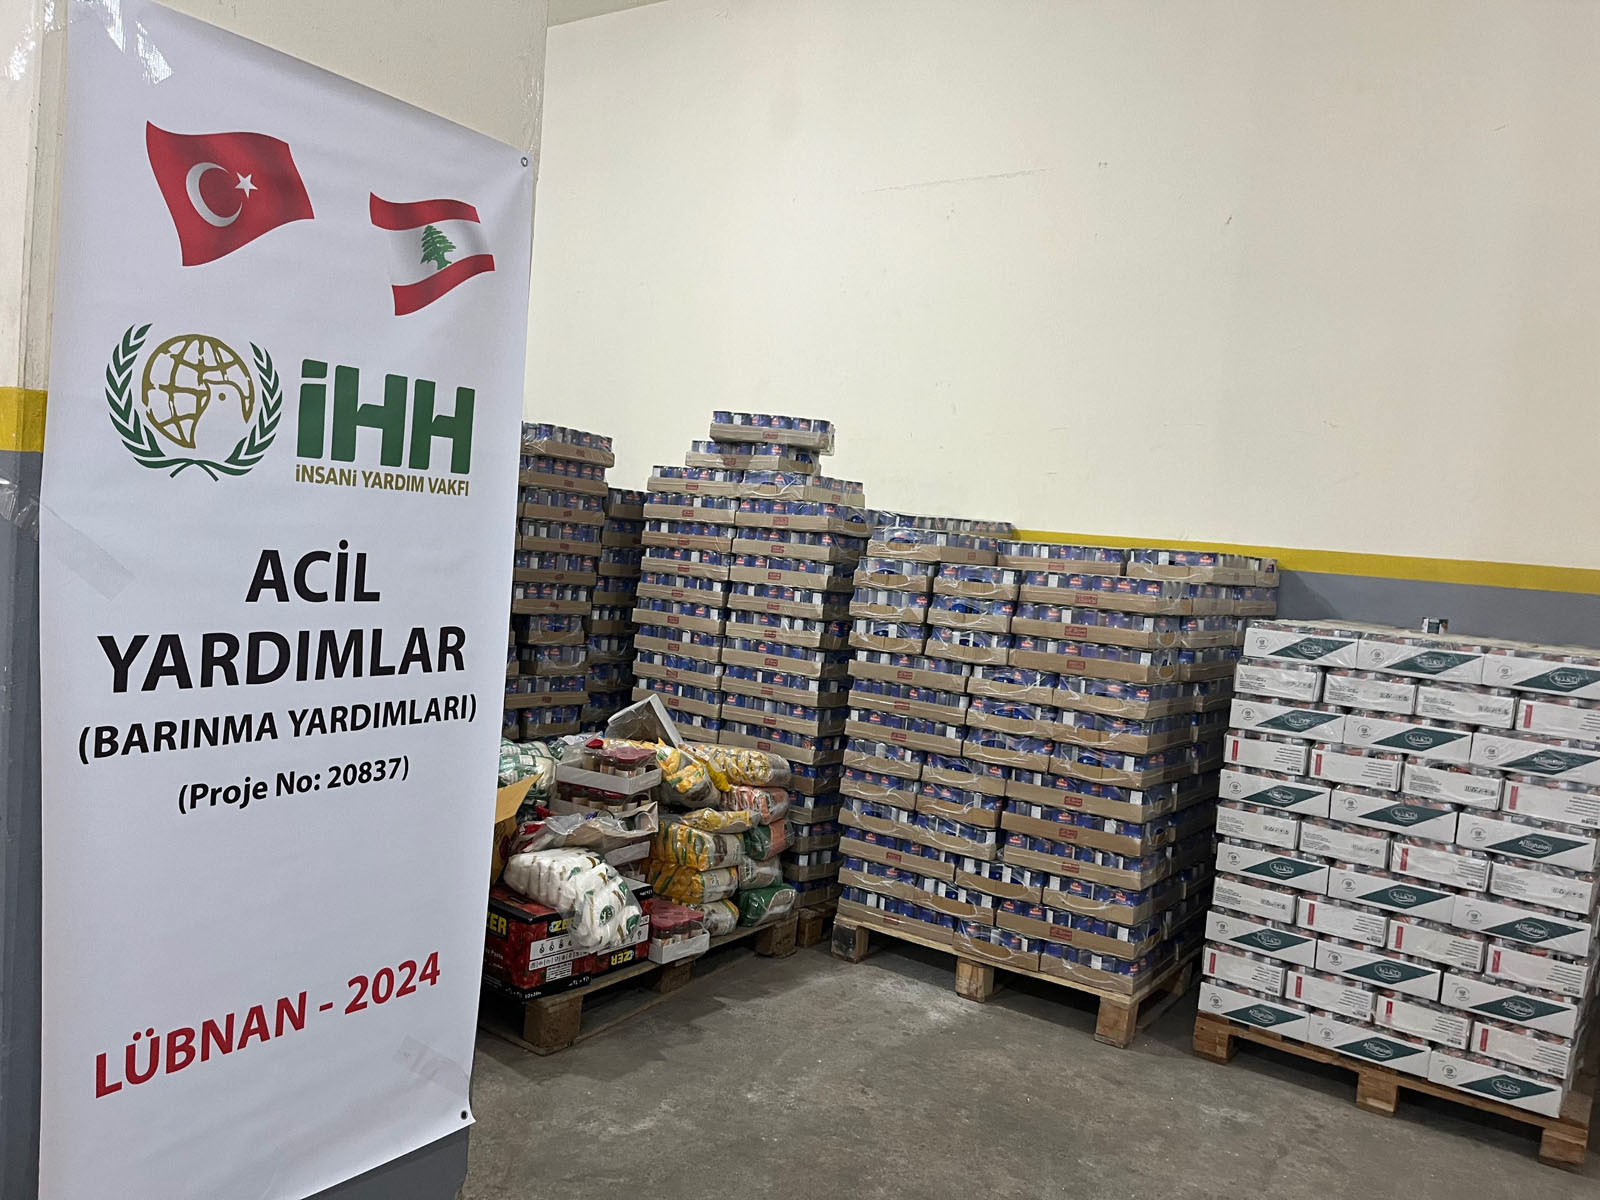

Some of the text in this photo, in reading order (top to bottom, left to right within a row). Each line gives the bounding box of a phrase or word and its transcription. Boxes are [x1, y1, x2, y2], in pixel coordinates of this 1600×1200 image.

[360, 471, 425, 492] YARDIM
[427, 477, 470, 497] VAKFI
[245, 539, 381, 603] ACİL
[96, 625, 466, 694] YARDIMLAR
[78, 693, 477, 765] (BARINMA YARDIMLARI)
[178, 755, 409, 815] (Proje No: 20837)
[487, 911, 507, 936] ER
[95, 951, 441, 1098] LÜBNAN - 2024
